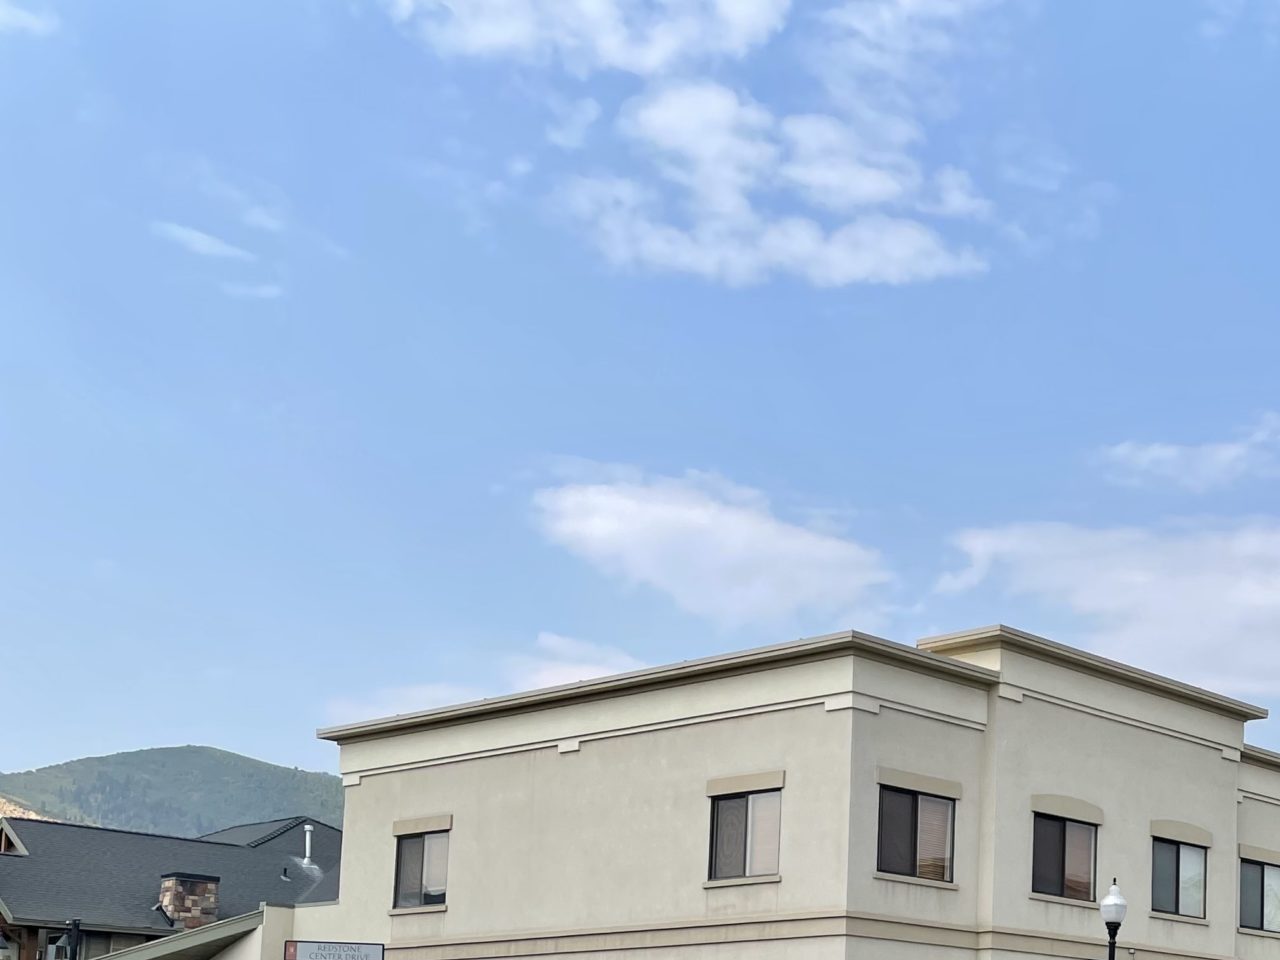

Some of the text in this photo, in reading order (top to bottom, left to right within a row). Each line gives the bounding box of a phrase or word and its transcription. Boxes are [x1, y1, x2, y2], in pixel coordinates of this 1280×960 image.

[317, 944, 361, 953] REDSTONE
[308, 952, 369, 960] CENTER DRIVE
